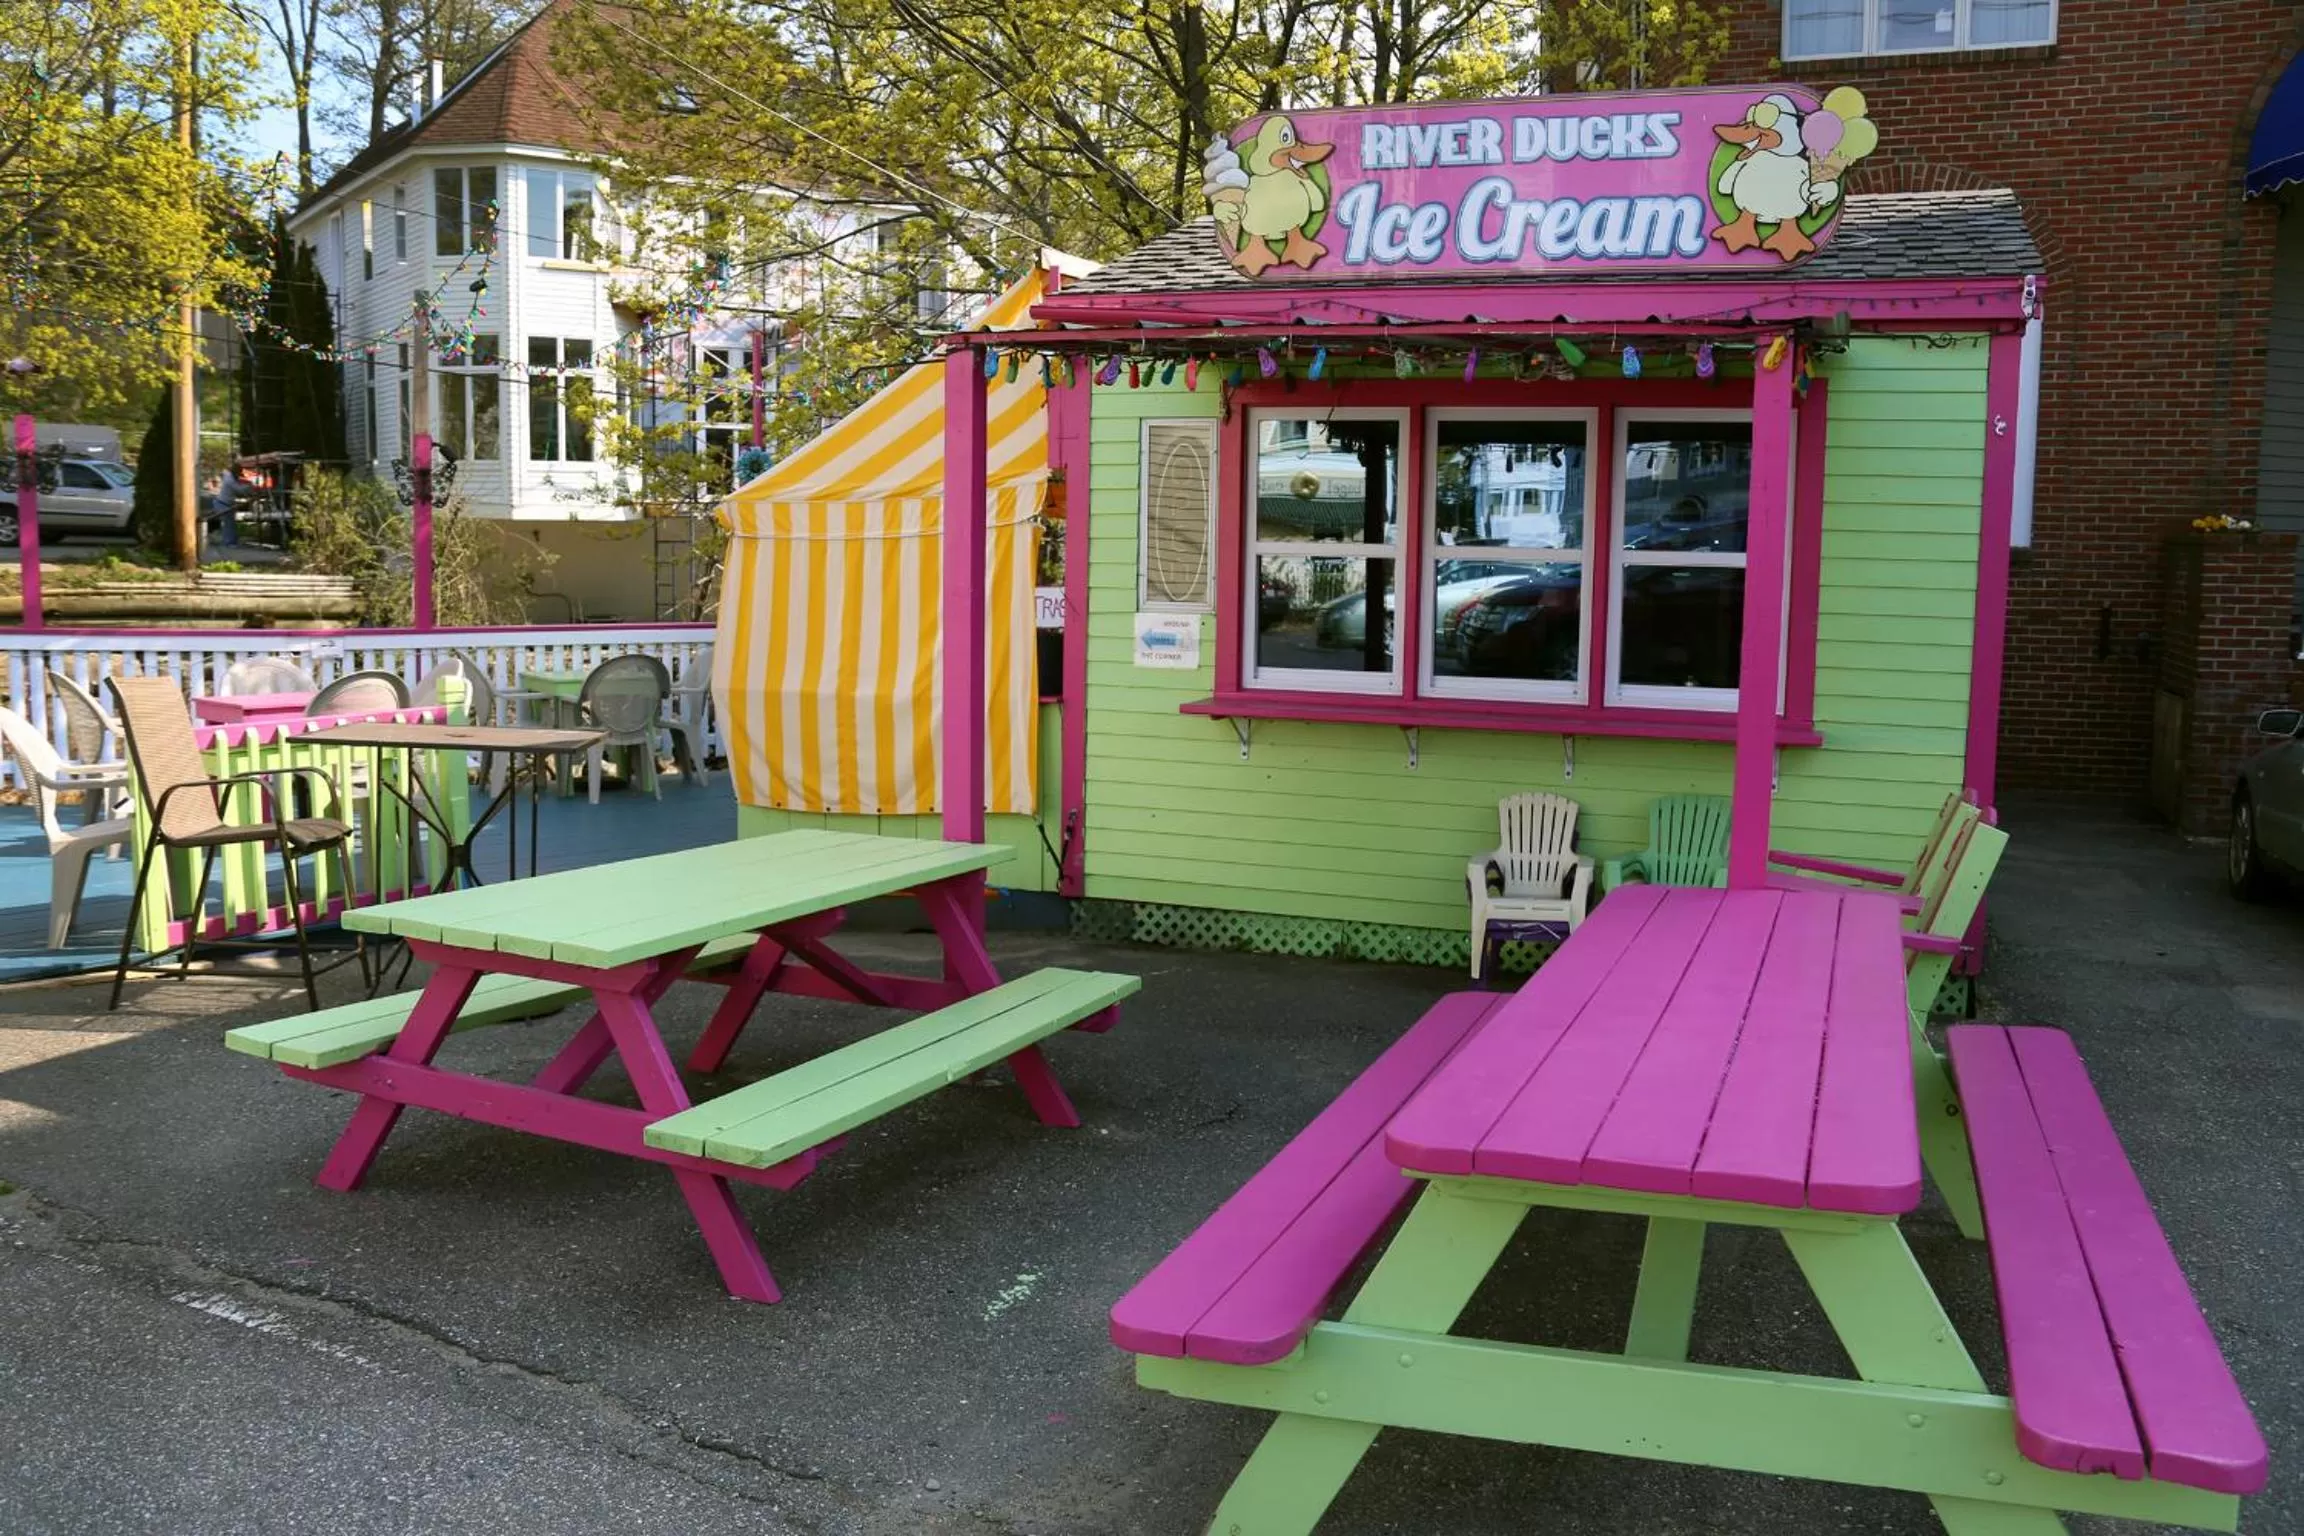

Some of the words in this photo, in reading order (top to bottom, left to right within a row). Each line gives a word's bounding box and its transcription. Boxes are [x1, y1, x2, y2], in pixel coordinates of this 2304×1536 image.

[1361, 117, 1504, 169] RIVER
[1512, 111, 1682, 163] DUCKS
[1336, 180, 1451, 264] Ice
[1454, 175, 1707, 264] Cream
